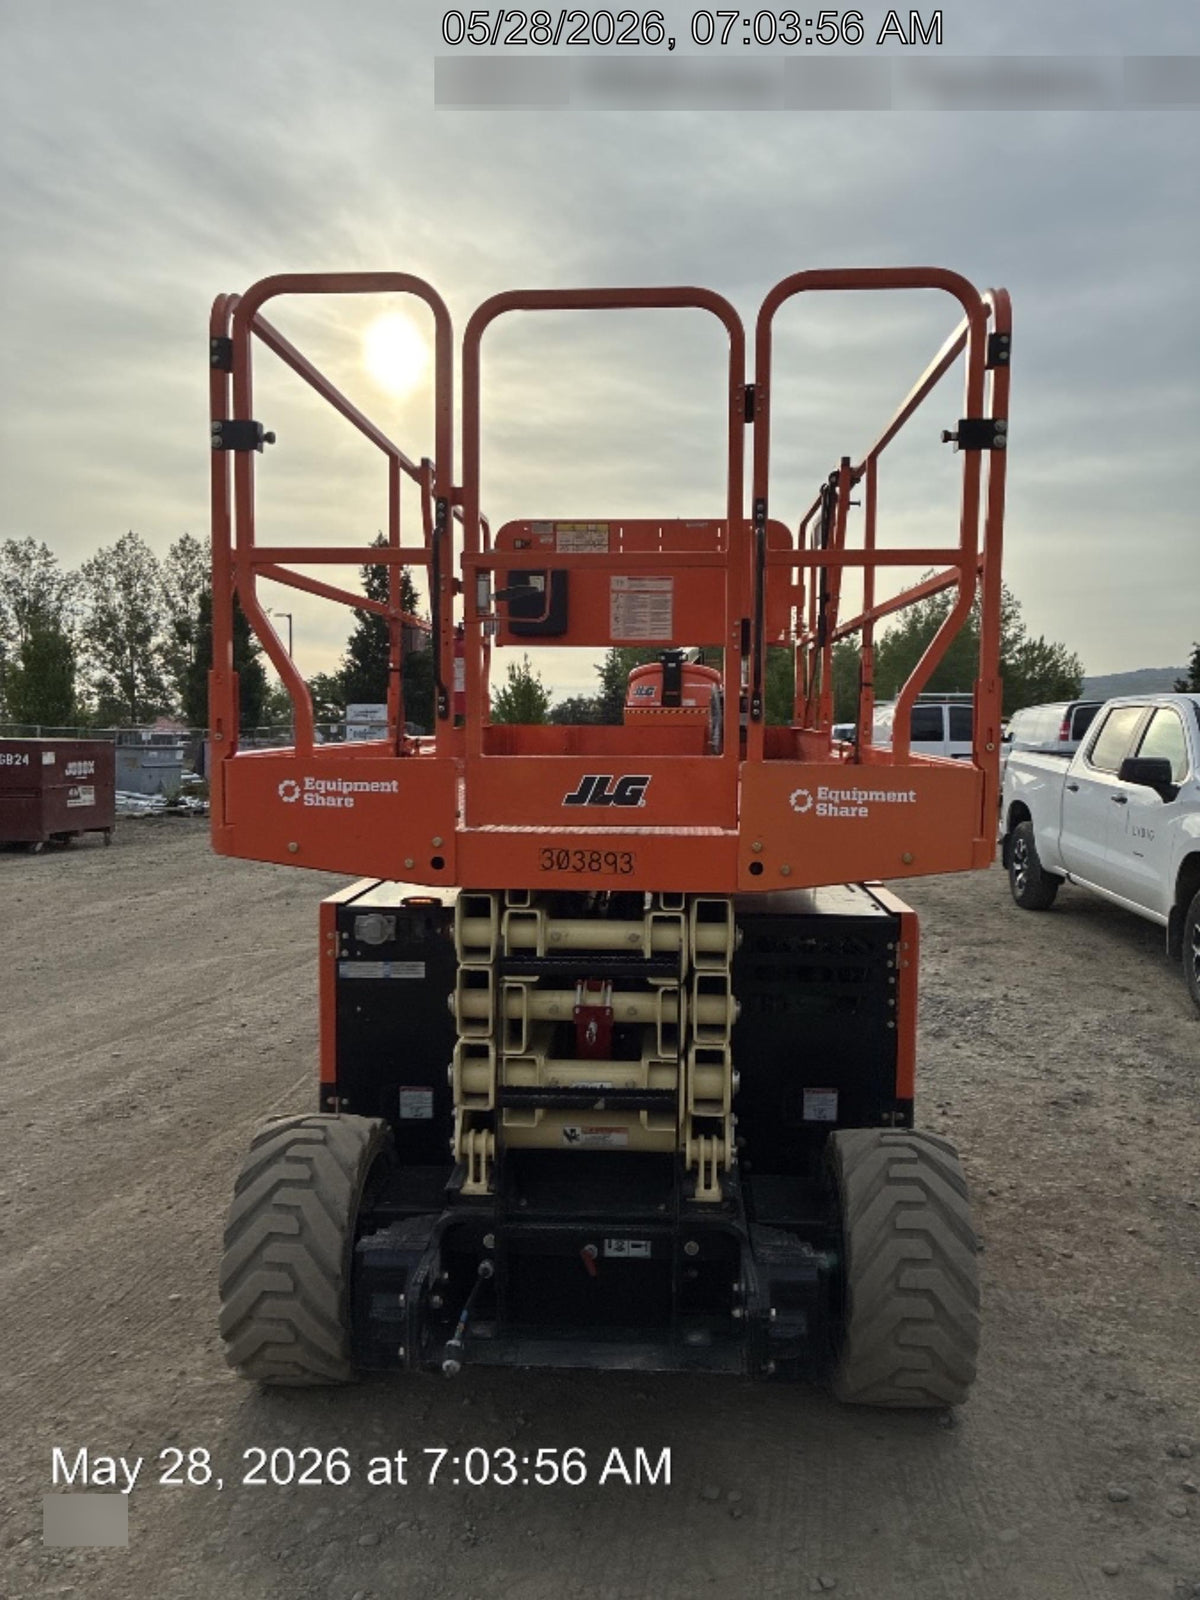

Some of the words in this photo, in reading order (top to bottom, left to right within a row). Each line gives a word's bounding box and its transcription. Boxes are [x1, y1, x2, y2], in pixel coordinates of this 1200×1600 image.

[633, 685, 656, 698] JLG
[303, 776, 399, 794] Equipment
[562, 774, 652, 808] JLG
[303, 792, 355, 807] Share
[816, 786, 917, 804] Equipment
[815, 802, 869, 817] Share
[541, 848, 634, 874] 303893
